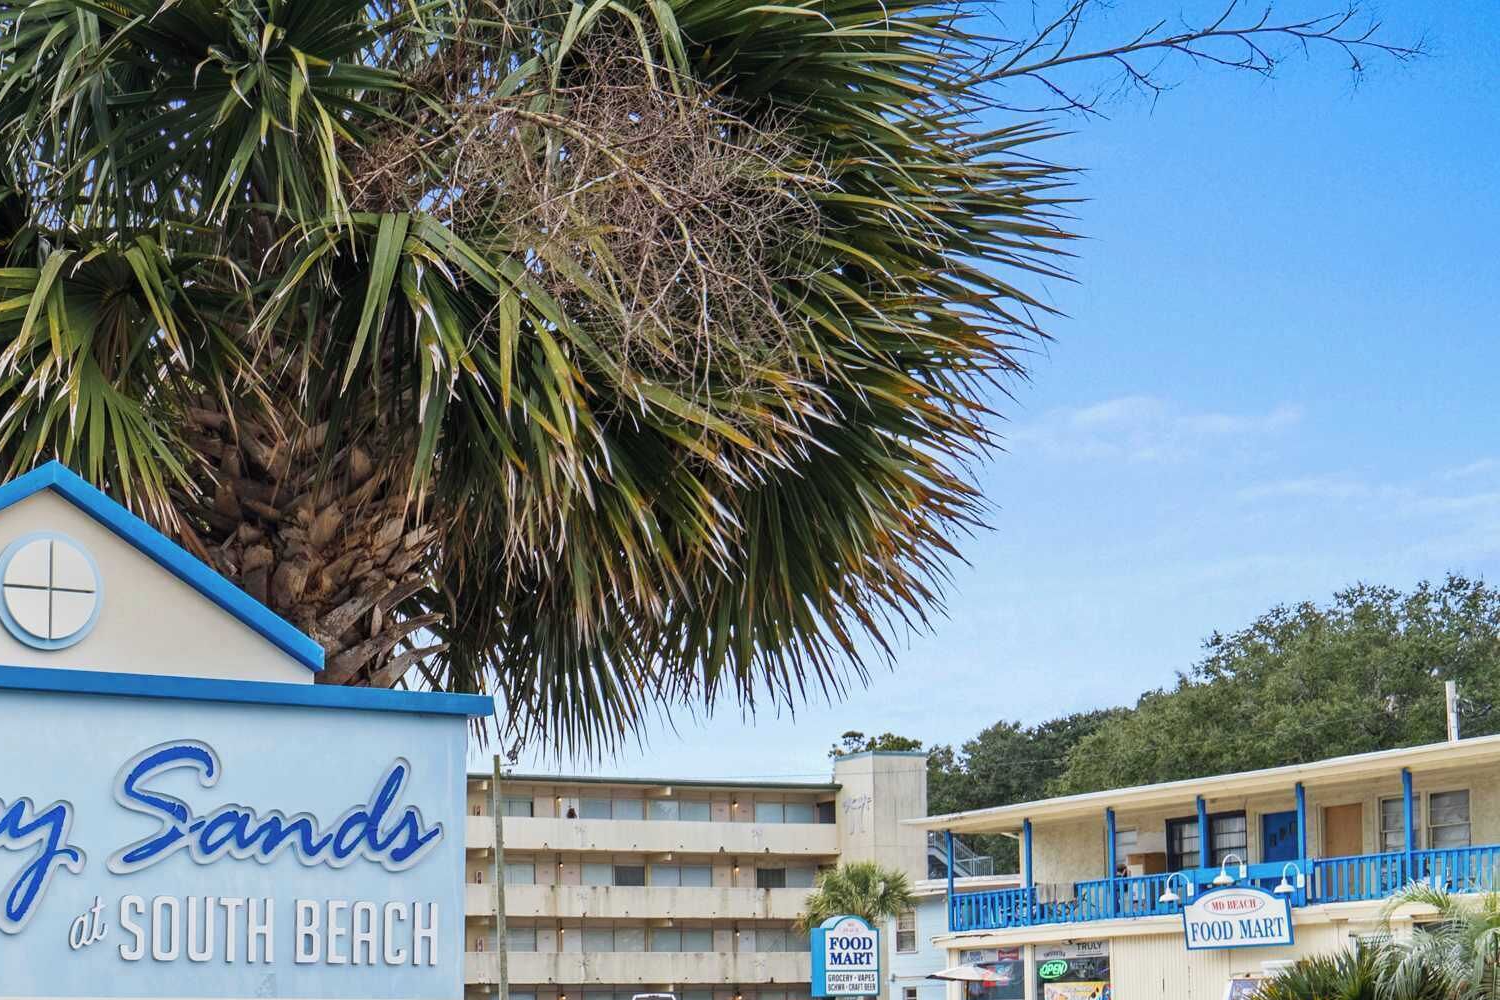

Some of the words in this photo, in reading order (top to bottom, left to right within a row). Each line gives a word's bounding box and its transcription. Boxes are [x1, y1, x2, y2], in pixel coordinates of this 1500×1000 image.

[111, 741, 443, 870] Sands
[1227, 899, 1256, 909] BEACH
[68, 896, 106, 951] at
[118, 894, 275, 964] SOUTH
[295, 899, 438, 966] BEACH
[1191, 920, 1234, 941] FOOD
[1239, 917, 1284, 939] MART
[829, 937, 873, 950] FOOD
[829, 952, 873, 965] MART
[1042, 963, 1065, 975] OPEN
[828, 974, 853, 982] GROCERY
[858, 973, 875, 982] VAPES
[849, 983, 863, 991] CRAFT
